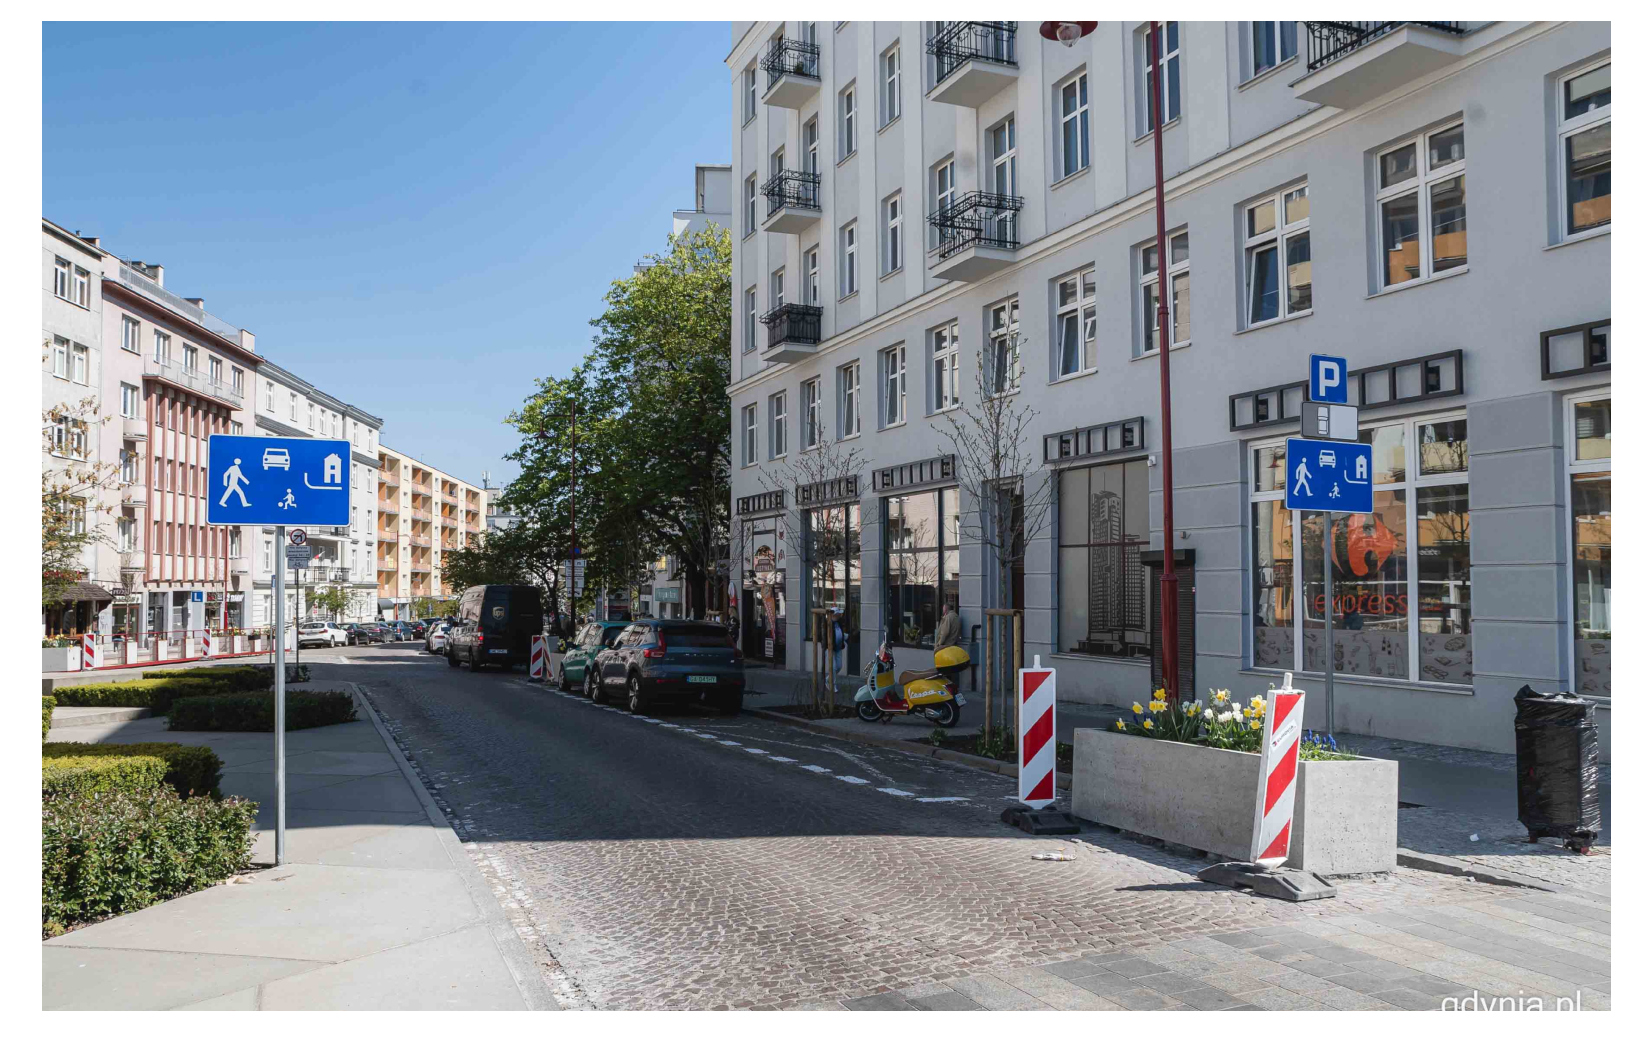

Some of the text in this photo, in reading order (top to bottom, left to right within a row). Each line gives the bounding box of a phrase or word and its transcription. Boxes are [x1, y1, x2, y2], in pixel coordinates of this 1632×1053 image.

[1319, 360, 1340, 397] P
[194, 592, 201, 602] L
[1314, 594, 1408, 616] express
[907, 687, 937, 699] Vespa
